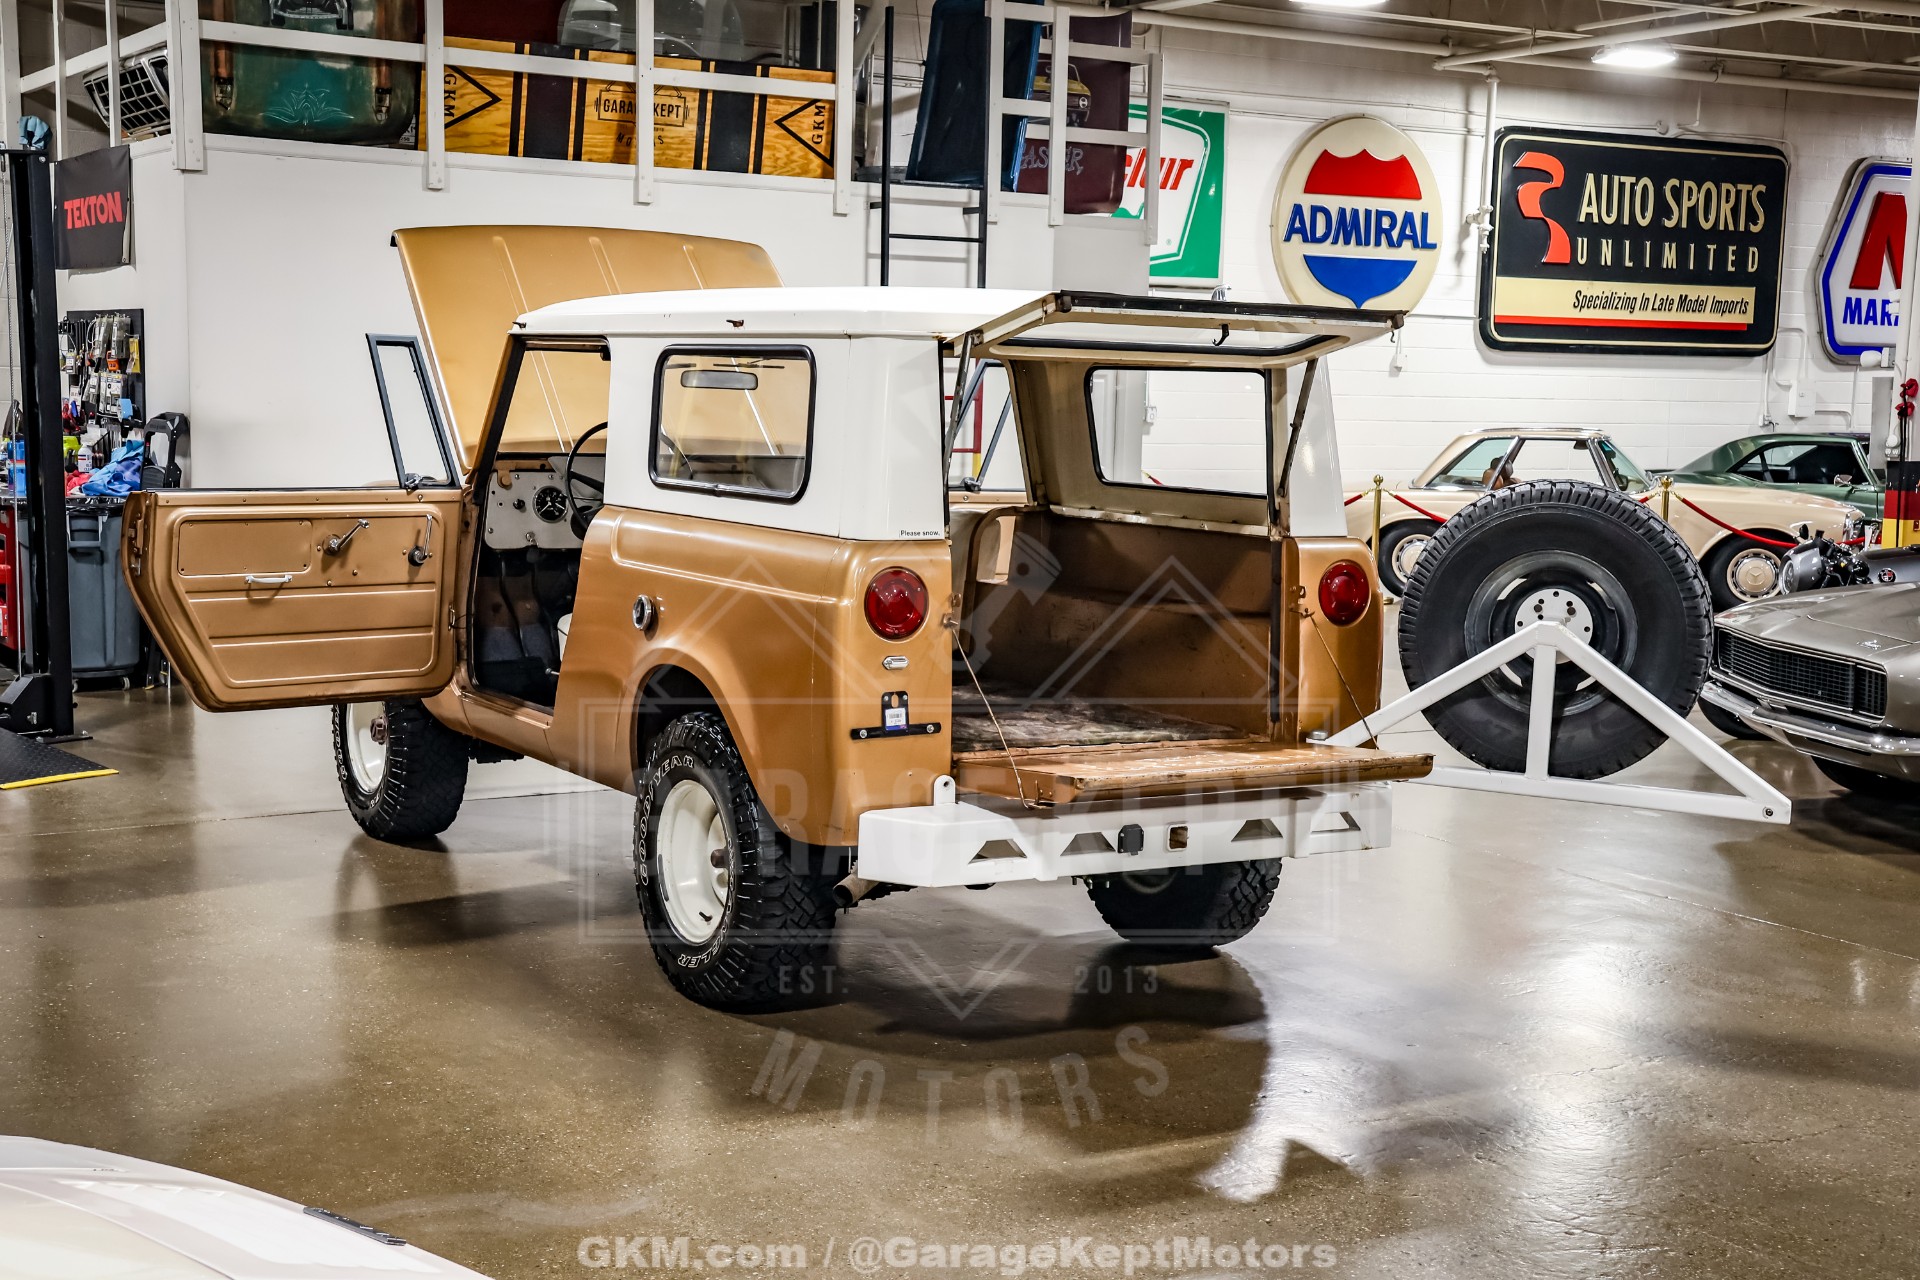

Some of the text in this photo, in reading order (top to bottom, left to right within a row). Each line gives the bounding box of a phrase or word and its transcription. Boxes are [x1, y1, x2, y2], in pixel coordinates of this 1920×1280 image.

[444, 73, 457, 118] GKM
[812, 104, 826, 144] GKM
[64, 191, 123, 229] TEKTON
[1579, 173, 1767, 233] AUTO SPORTS
[1283, 203, 1438, 249] ADMIRAL
[1576, 236, 1759, 273] UNLIMITED
[1573, 290, 1749, 317] Specializing In Late Model Imports
[900, 529, 920, 537] Please
